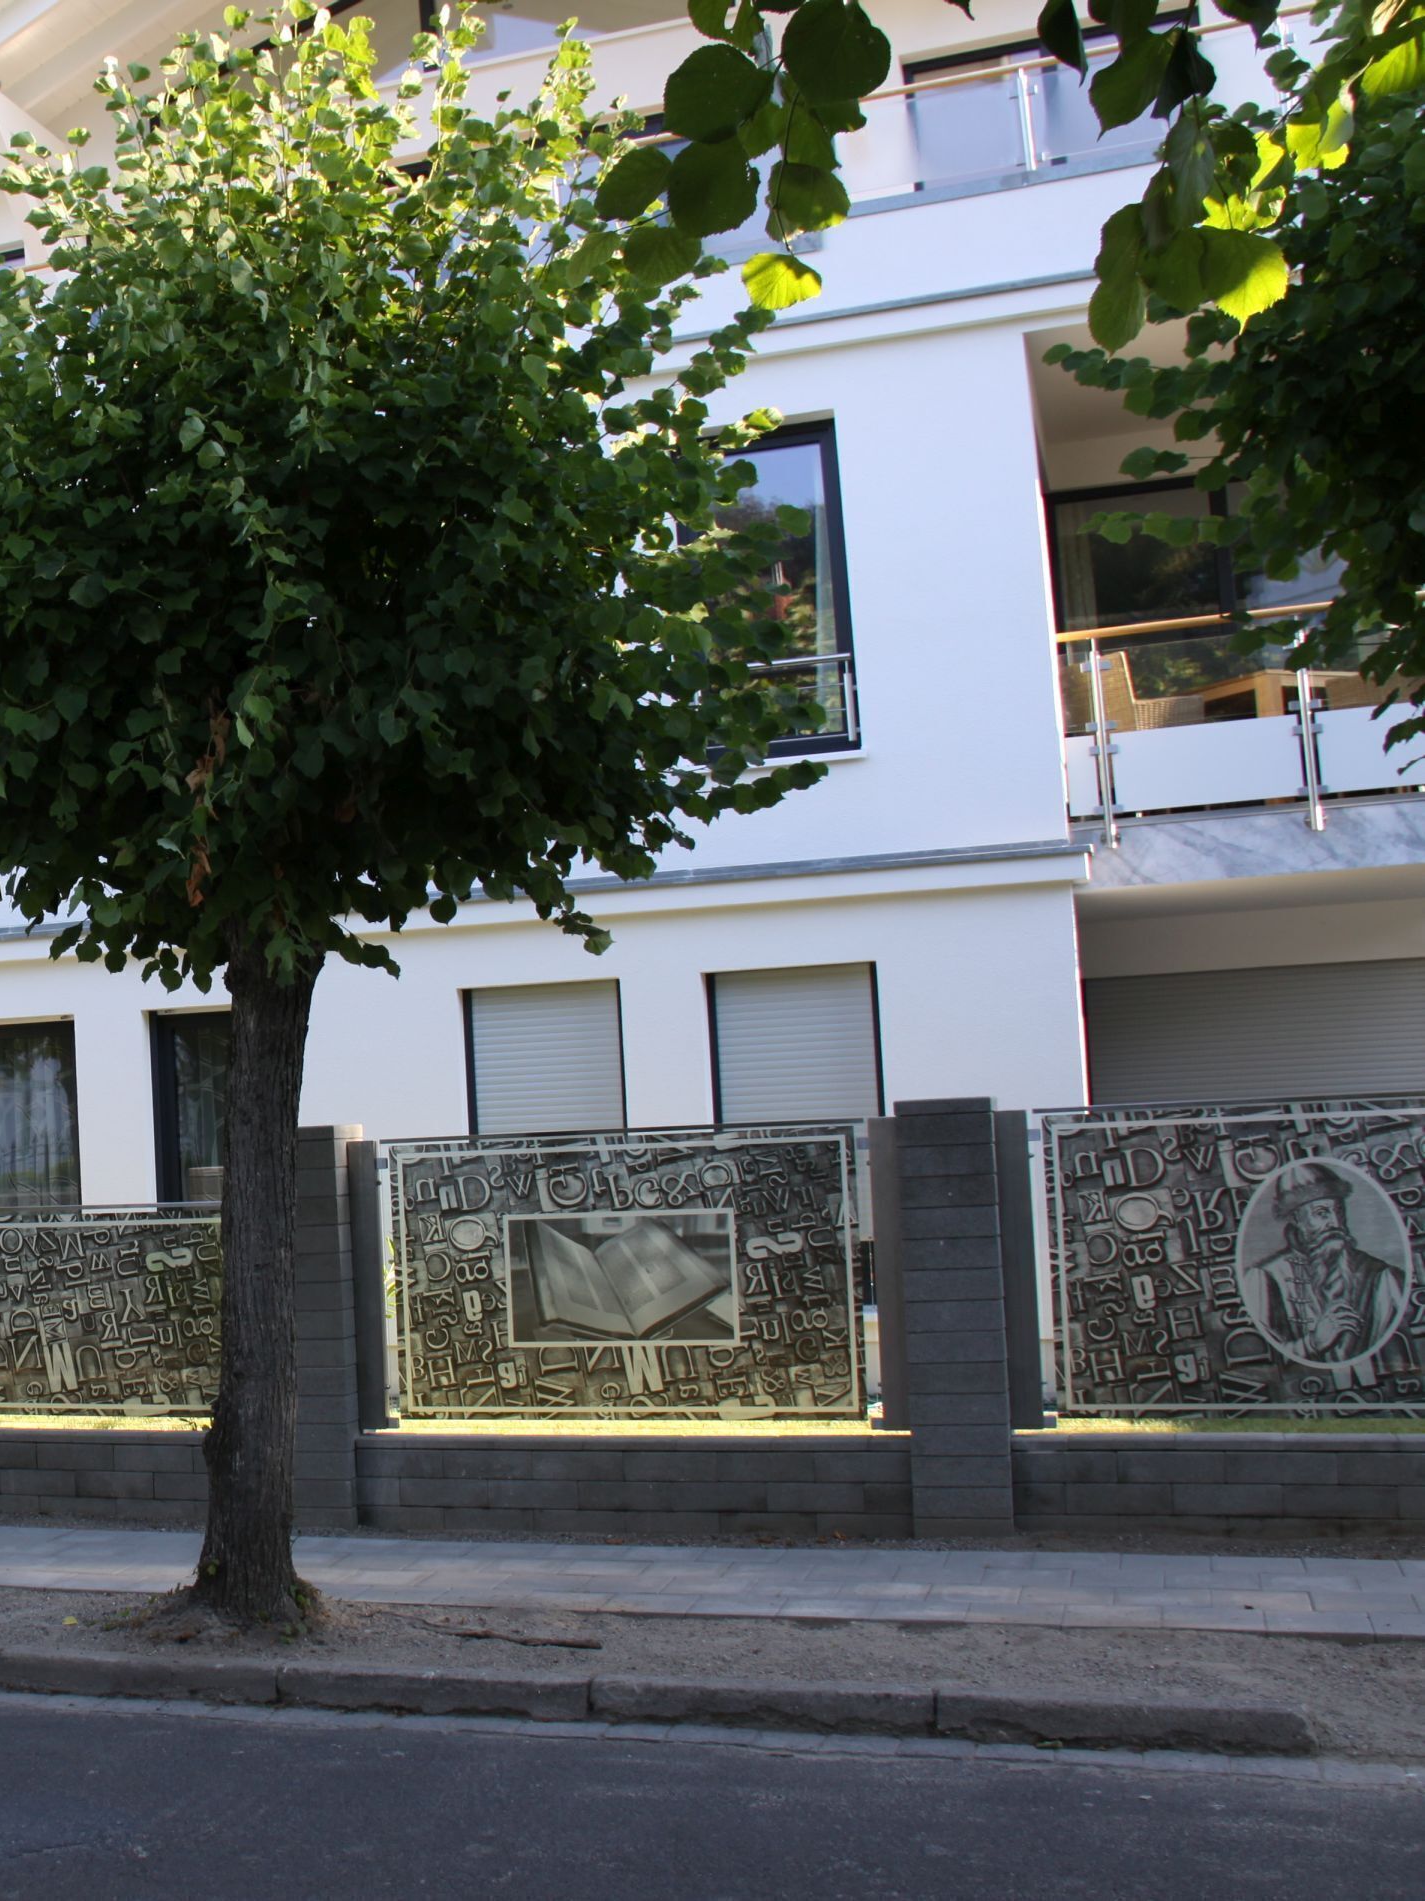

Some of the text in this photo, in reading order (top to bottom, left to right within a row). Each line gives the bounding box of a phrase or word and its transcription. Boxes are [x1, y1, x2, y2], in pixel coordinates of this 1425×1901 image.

[1124, 1147, 1165, 1187] D
[455, 1175, 491, 1210] D
[0, 1228, 23, 1254] O
[1166, 1305, 1204, 1340] H
[411, 1355, 426, 1379] B
[428, 1356, 456, 1387] H
[1071, 1348, 1087, 1375] B
[1090, 1349, 1125, 1383] H
